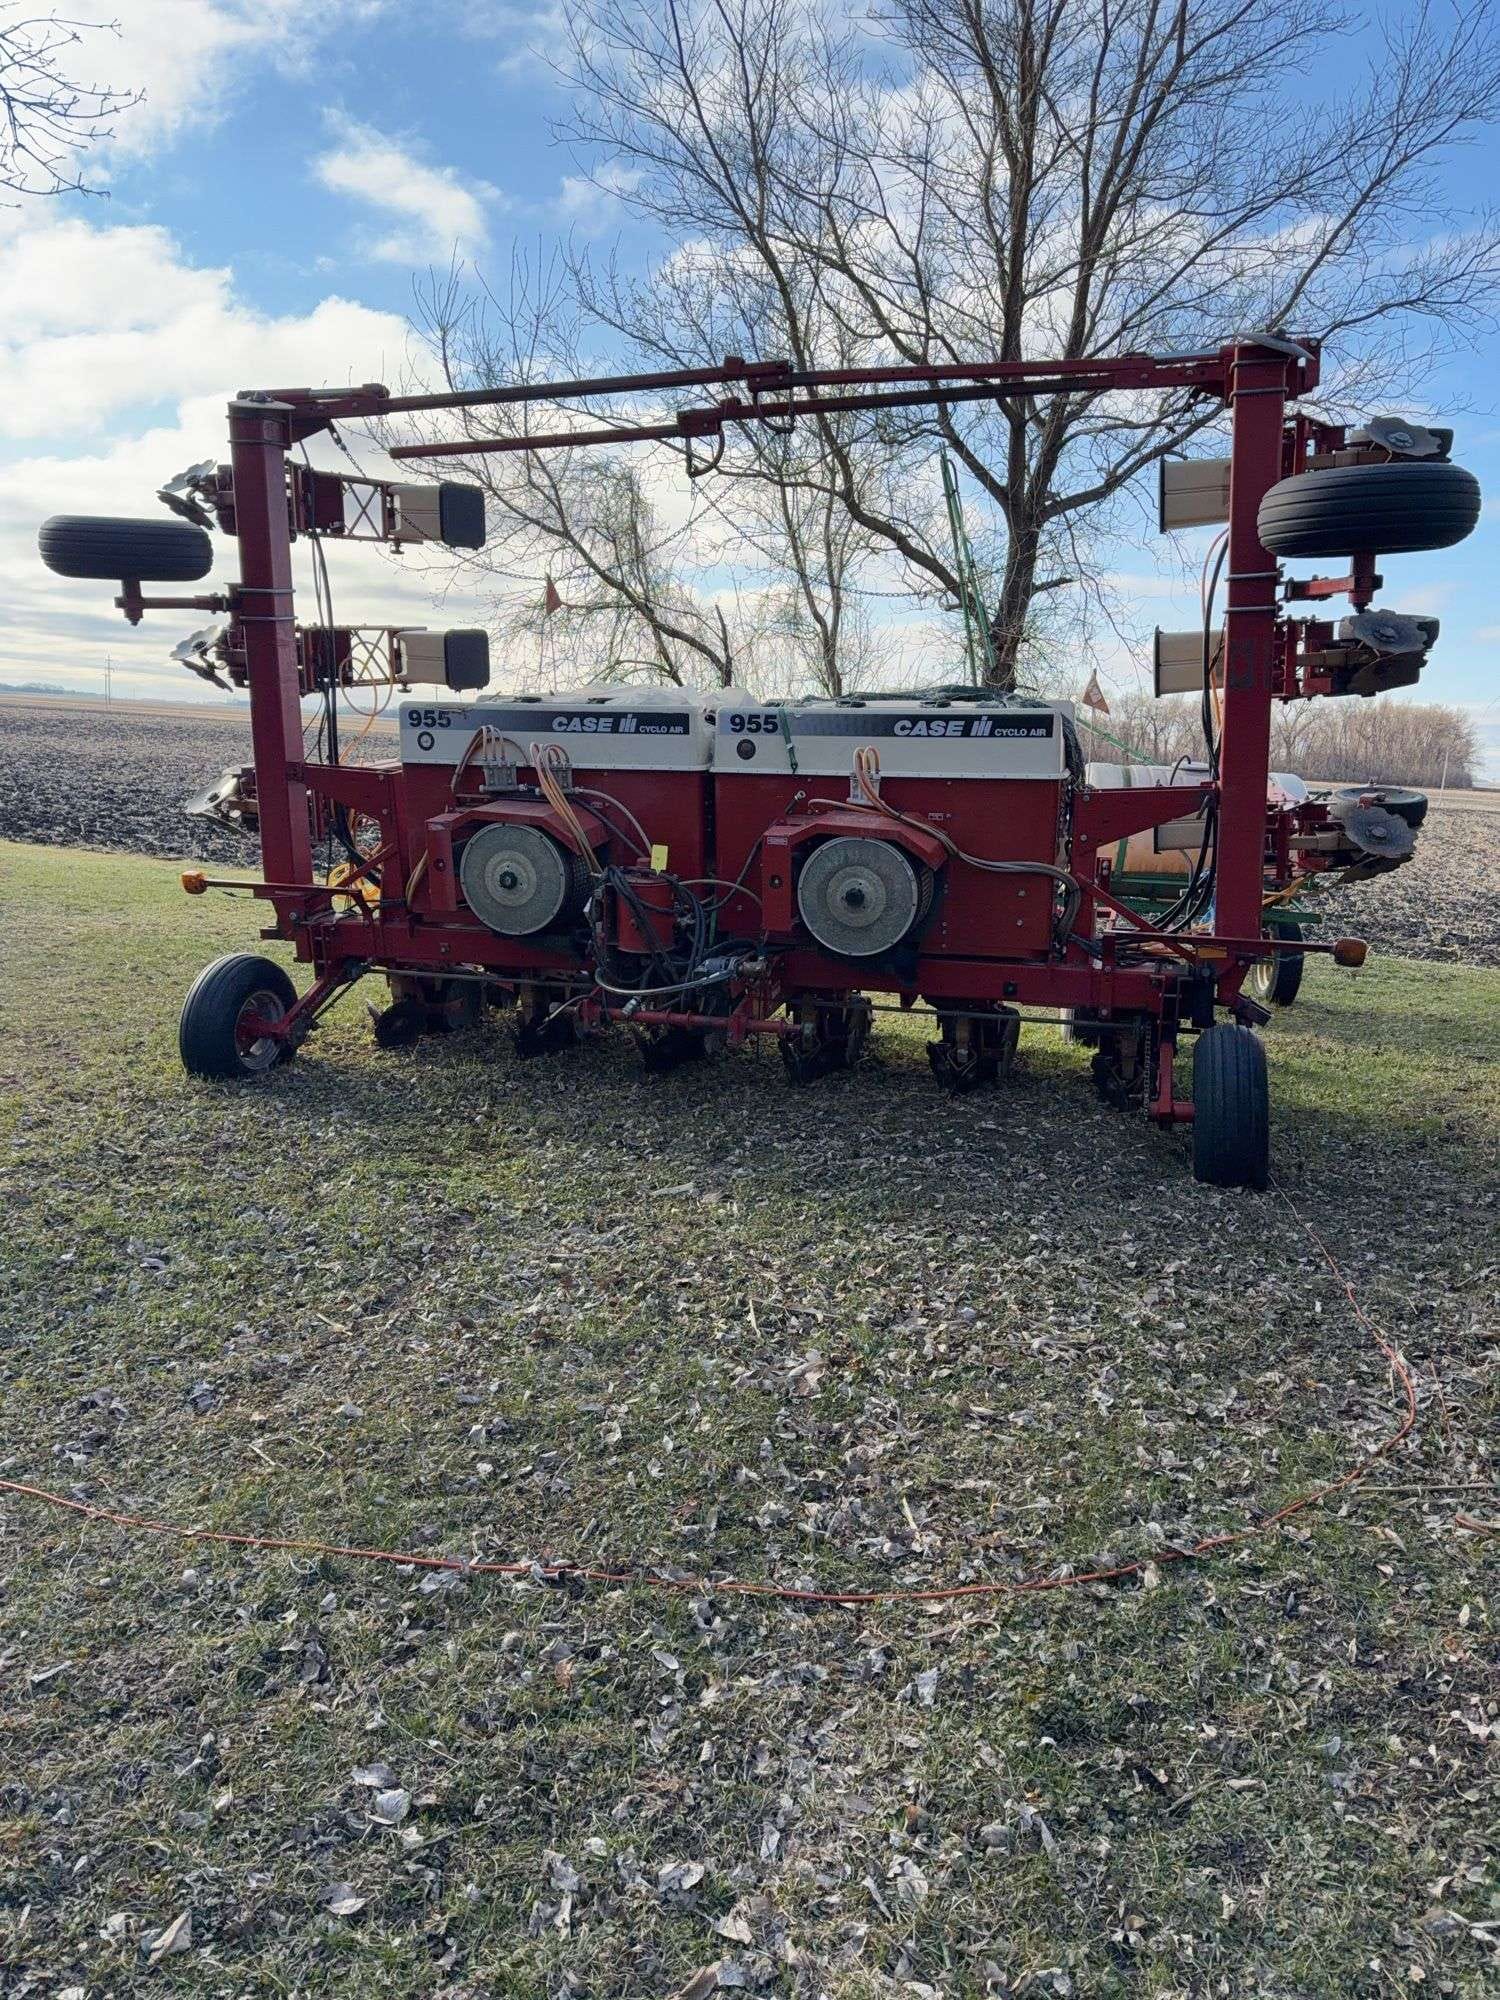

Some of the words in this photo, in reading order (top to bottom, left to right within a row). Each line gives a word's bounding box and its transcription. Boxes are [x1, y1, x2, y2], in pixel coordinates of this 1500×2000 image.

[408, 709, 451, 728] 955
[552, 717, 612, 732] CASE
[639, 725, 667, 734] CYCLO
[669, 725, 684, 734] AIR
[730, 714, 779, 734] 955
[894, 720, 963, 736] CASE
[995, 729, 1027, 737] CYCLO
[1030, 729, 1046, 737] AIR
